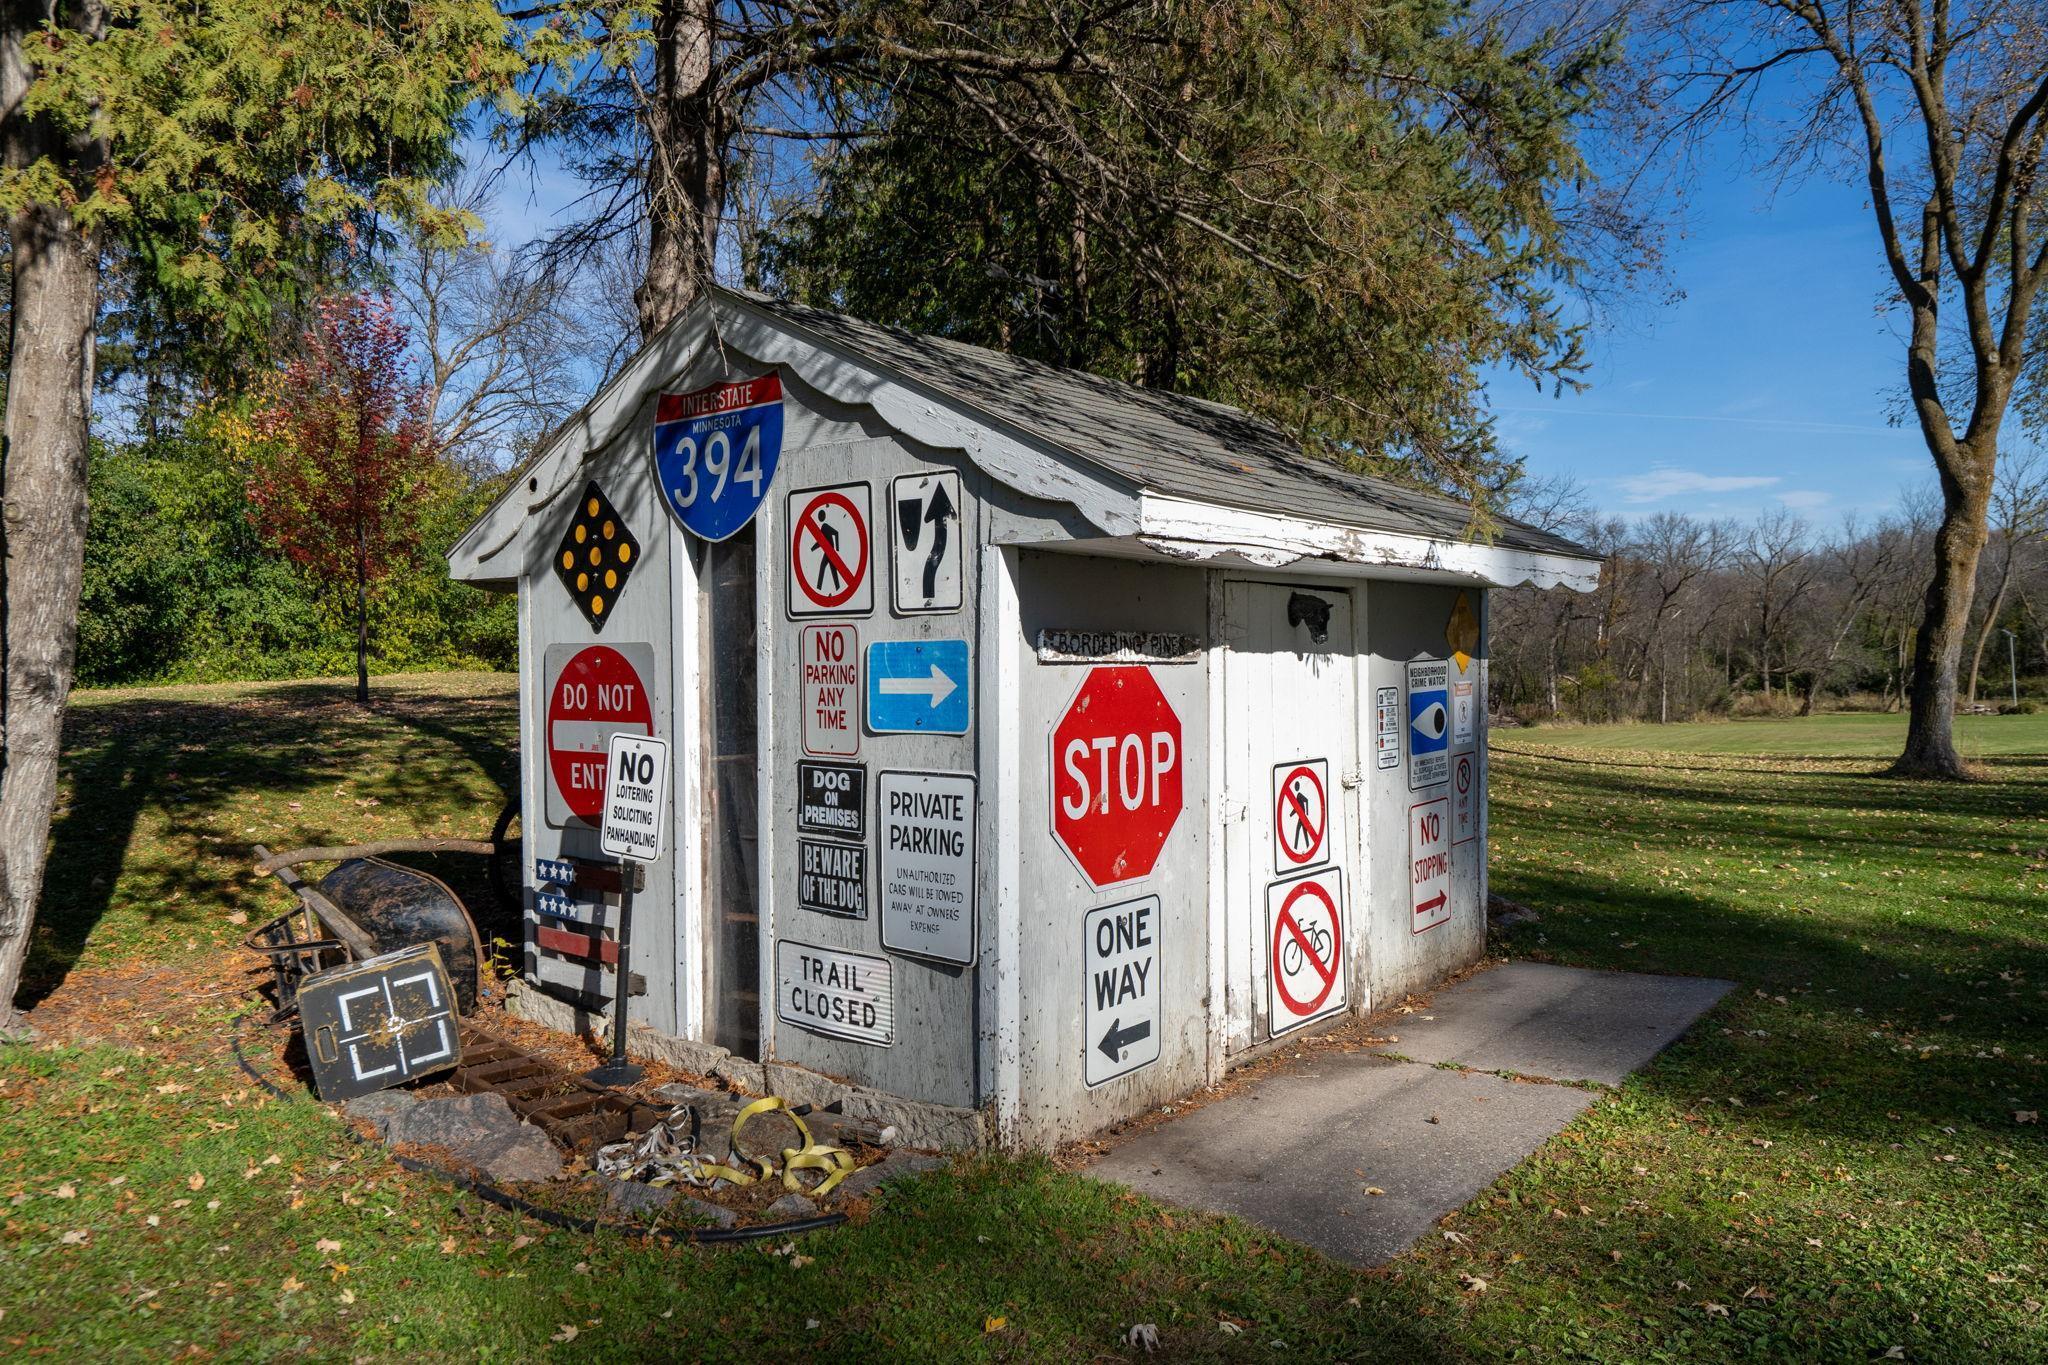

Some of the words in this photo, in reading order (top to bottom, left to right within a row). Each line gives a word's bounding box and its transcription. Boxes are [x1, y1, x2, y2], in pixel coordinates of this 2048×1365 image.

[682, 384, 753, 415] INTERSTATE
[692, 415, 742, 434] MINNESOTA
[674, 425, 763, 508] 394
[816, 630, 844, 662] NO
[1058, 634, 1143, 656] BORDERING
[1150, 635, 1185, 656] PINES
[806, 664, 856, 685] PARKING
[1409, 665, 1447, 677] NEIGHBORHOOD
[1411, 677, 1426, 688] CRIME
[1428, 675, 1446, 686] WATCH
[563, 683, 588, 710] DO
[598, 684, 635, 711] NOT
[817, 687, 845, 707] ANY
[816, 710, 847, 730] TIME
[571, 762, 605, 791] ENT
[619, 751, 654, 785] NO
[813, 770, 850, 791] DOG
[1063, 731, 1176, 821] STOP
[616, 784, 653, 803] LOITERING
[824, 791, 839, 806] ON
[890, 791, 964, 821] PRIVATE
[613, 805, 652, 825] SOLICITING
[805, 805, 859, 829] PREMISES
[606, 826, 655, 848] PANHANDLING
[890, 825, 964, 857] PARKING
[1420, 813, 1440, 846] NO
[804, 844, 860, 879] BEWARE
[1414, 852, 1447, 884] STOPPING
[896, 867, 956, 886] UNAUTHORIZED
[803, 874, 816, 901] OF
[817, 877, 837, 906] THE
[839, 880, 863, 910] DOG
[888, 882, 907, 896] CARS
[908, 886, 924, 899] WILL
[926, 888, 934, 900] BE
[935, 889, 964, 904] TOWED
[891, 901, 913, 913] AWAY
[916, 904, 925, 915] AT
[927, 906, 960, 921] OWNER'S
[910, 920, 940, 934] EXPENSE
[1096, 907, 1152, 959] ONE
[801, 955, 864, 992] TRAIL
[1094, 956, 1153, 1012] WAY
[792, 987, 876, 1028] CLOSED
